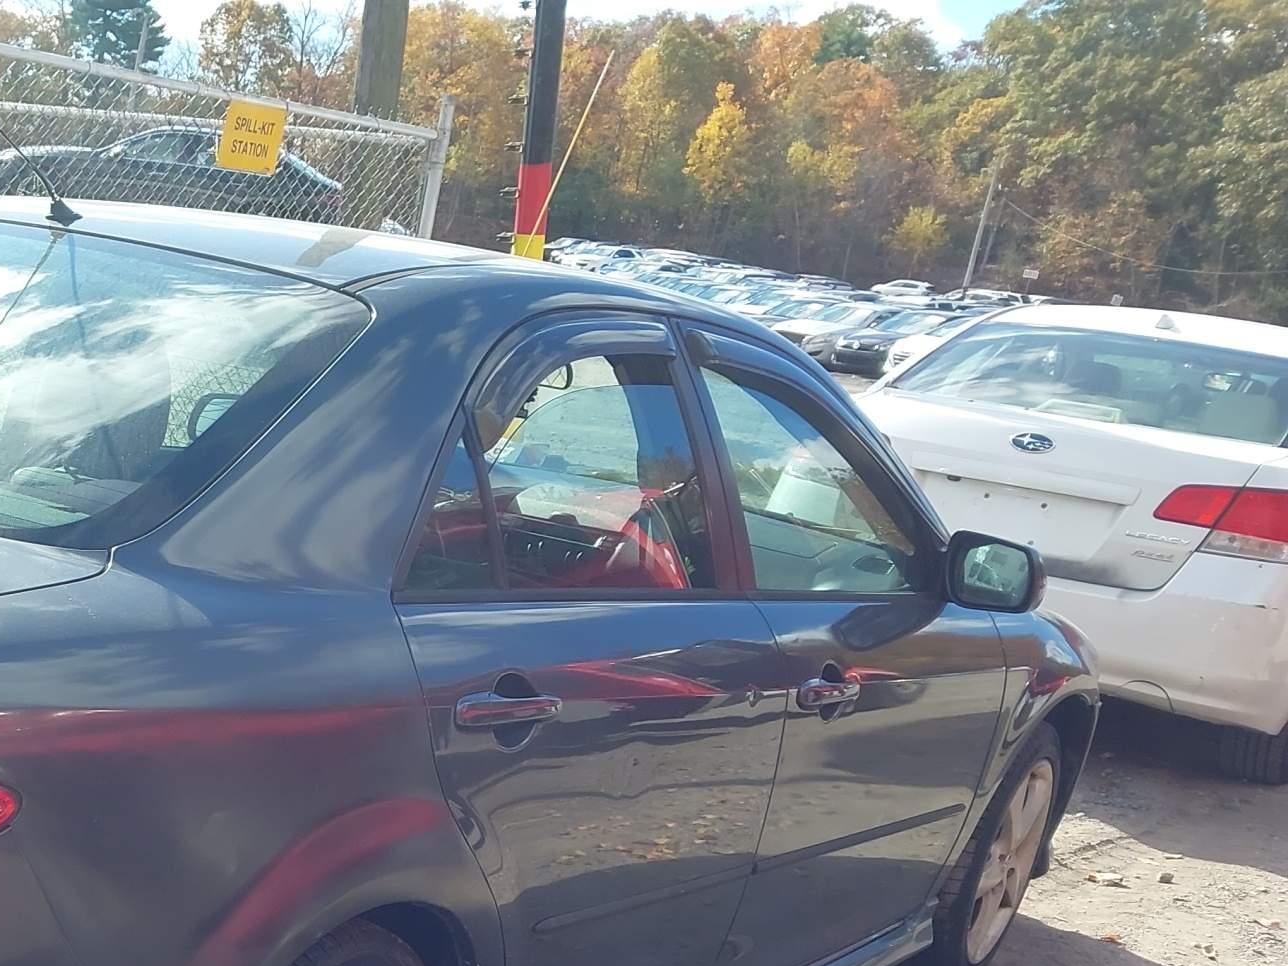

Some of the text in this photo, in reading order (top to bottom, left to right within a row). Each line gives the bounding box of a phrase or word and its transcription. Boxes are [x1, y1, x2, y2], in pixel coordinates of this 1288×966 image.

[235, 117, 275, 135] SPILL-KIT
[231, 139, 269, 159] STATION
[1125, 530, 1191, 545] LEGACY
